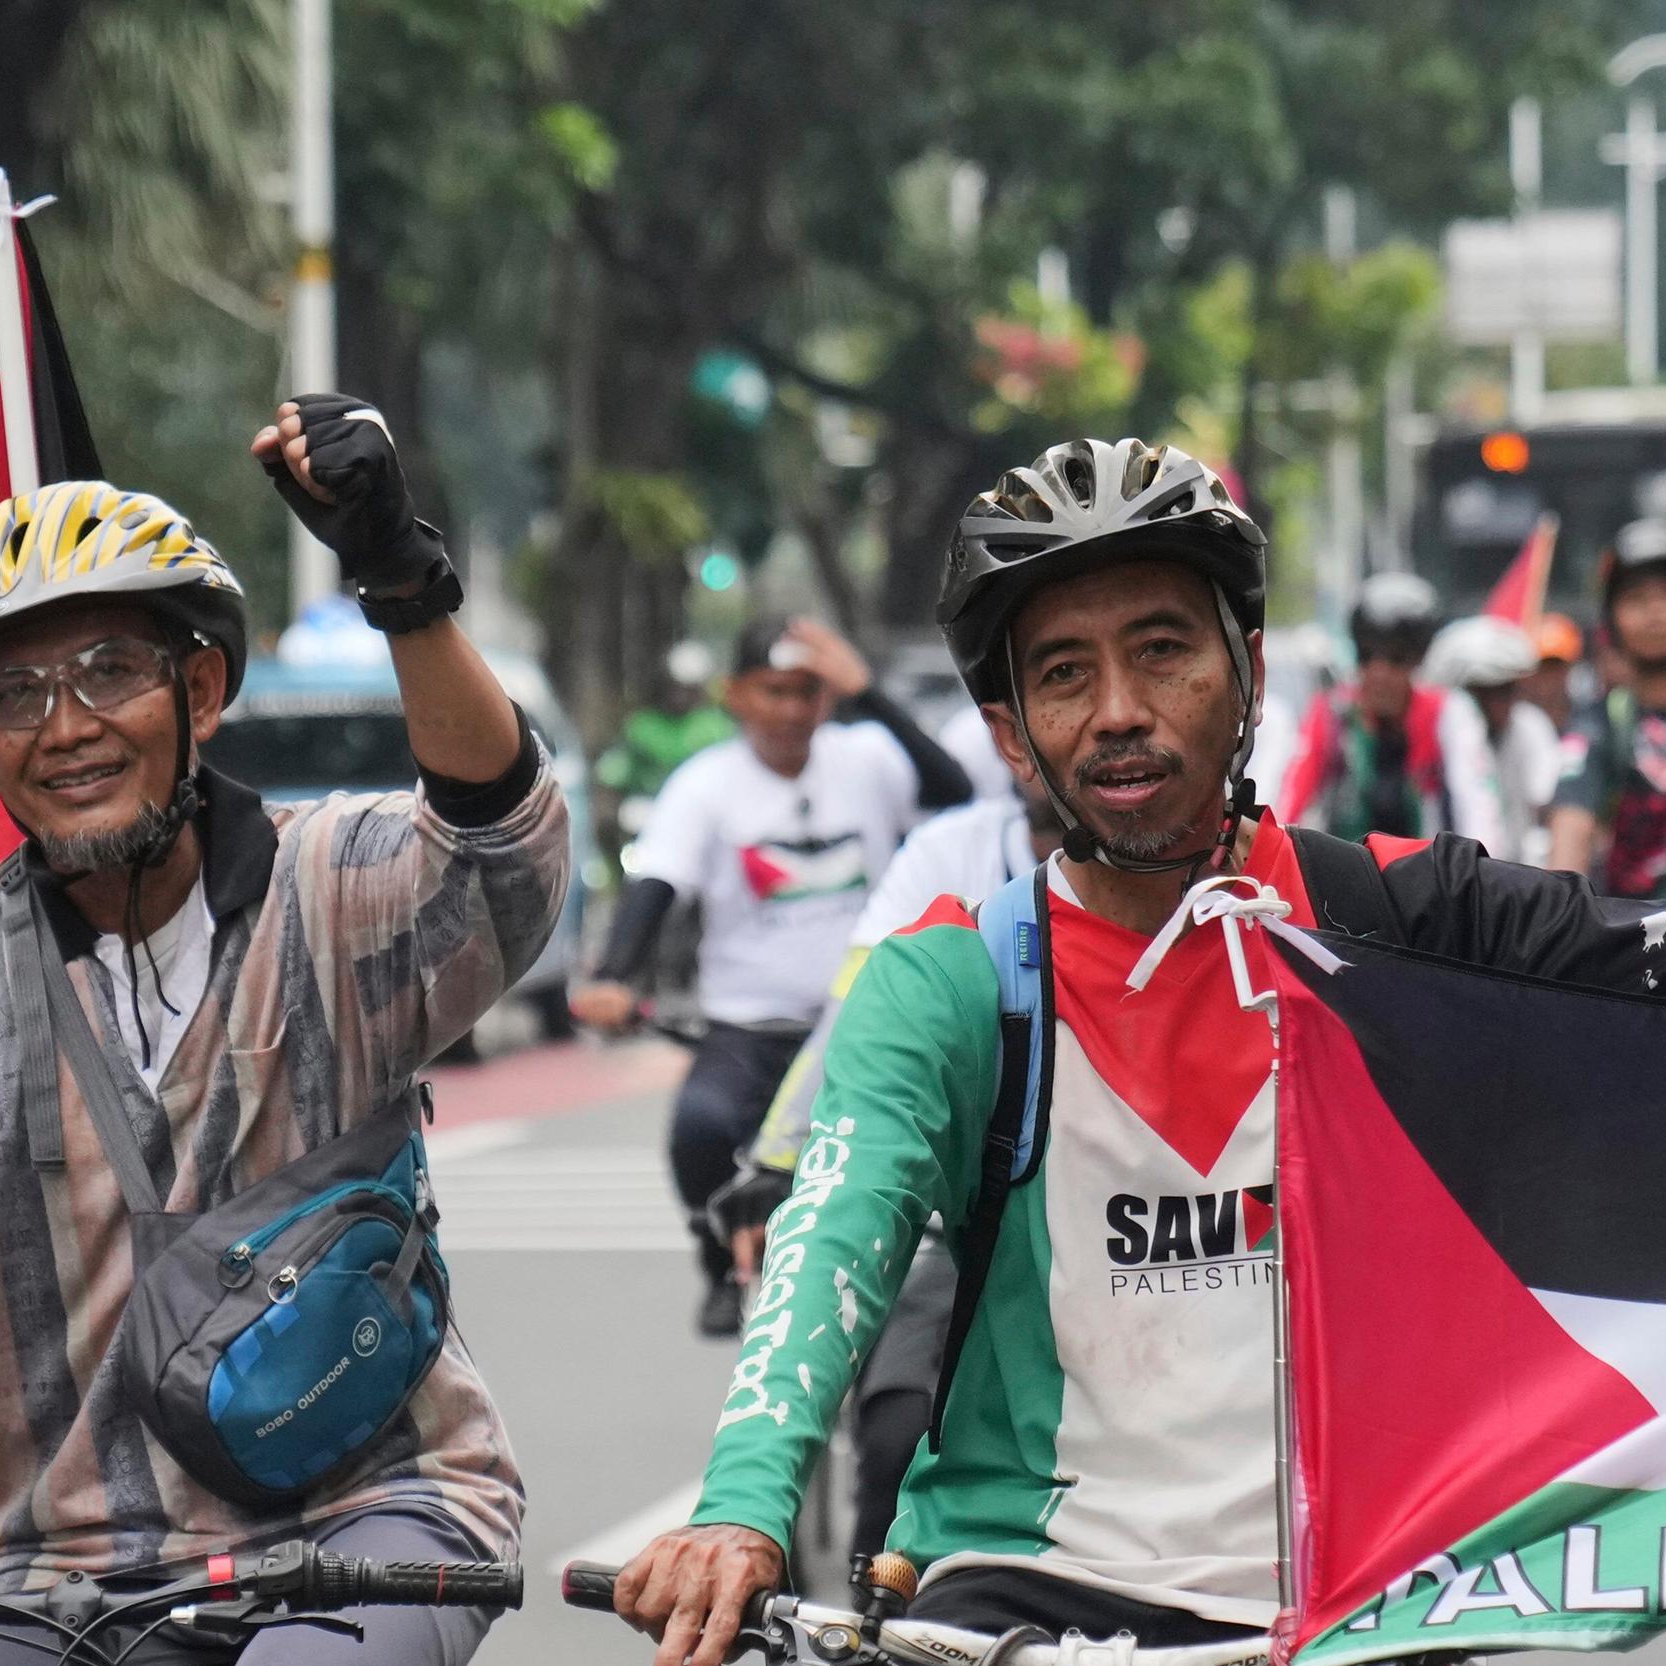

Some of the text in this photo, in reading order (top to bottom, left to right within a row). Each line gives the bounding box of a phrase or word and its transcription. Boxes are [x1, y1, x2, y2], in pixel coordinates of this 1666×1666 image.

[1111, 1262, 1274, 1297] PALESTI
[255, 1356, 351, 1439] BOBO OUTDOOR
[912, 1633, 979, 1666] ZOOM
